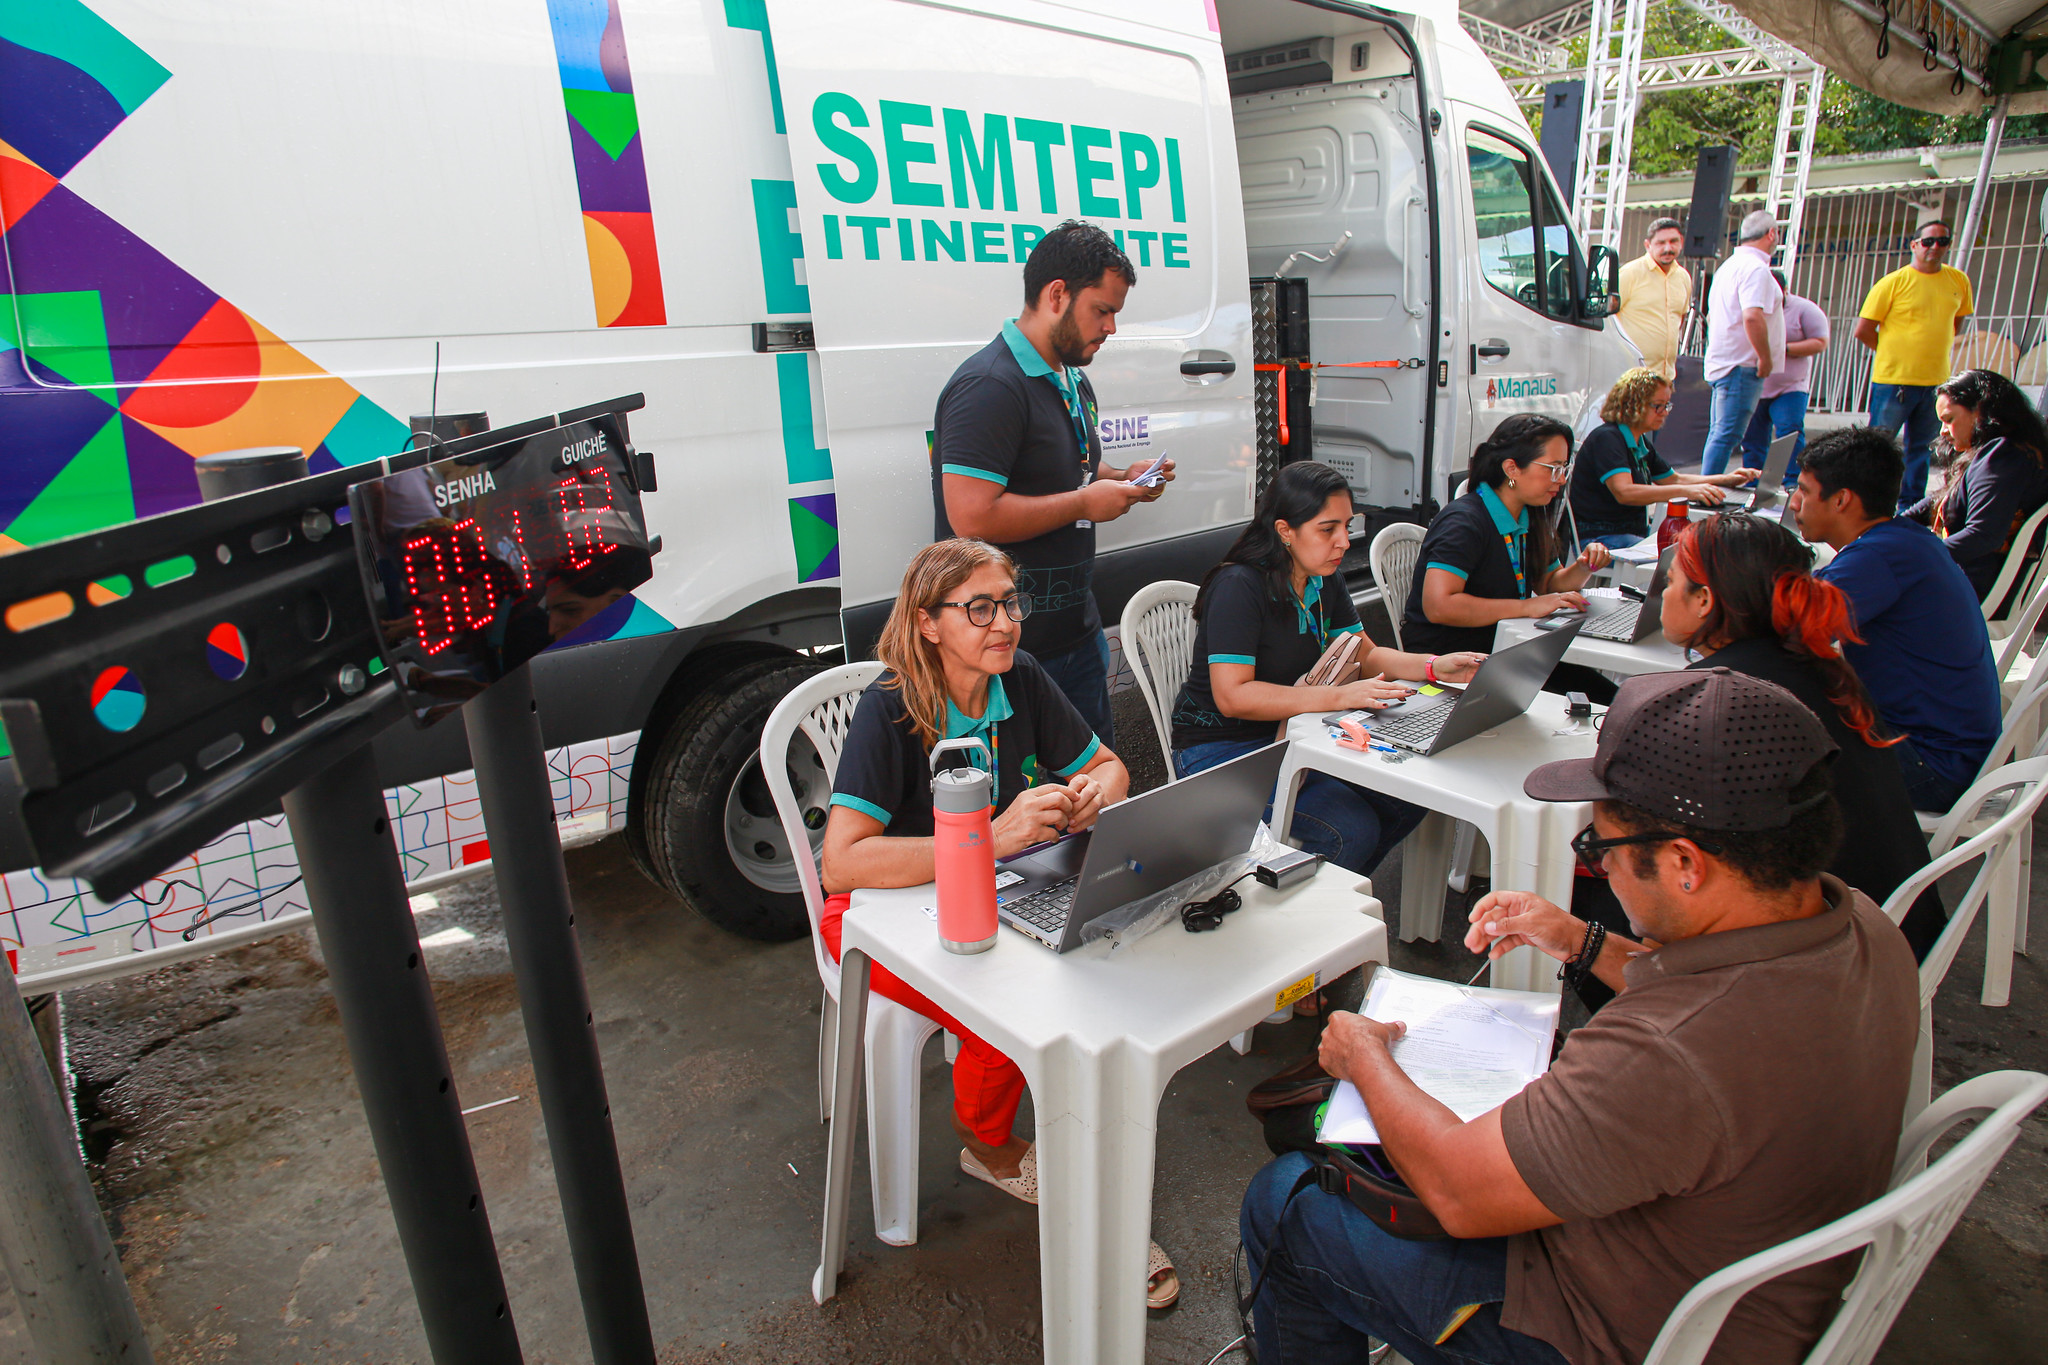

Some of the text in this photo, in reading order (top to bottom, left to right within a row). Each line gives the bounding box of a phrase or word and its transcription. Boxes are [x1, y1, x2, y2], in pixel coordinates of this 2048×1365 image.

[812, 91, 1187, 223] SEMTEPI
[822, 214, 1190, 268] ITINERTE
[1498, 377, 1557, 399] Manaus
[561, 430, 607, 466] GUICHÊ
[434, 470, 496, 508] SENHA
